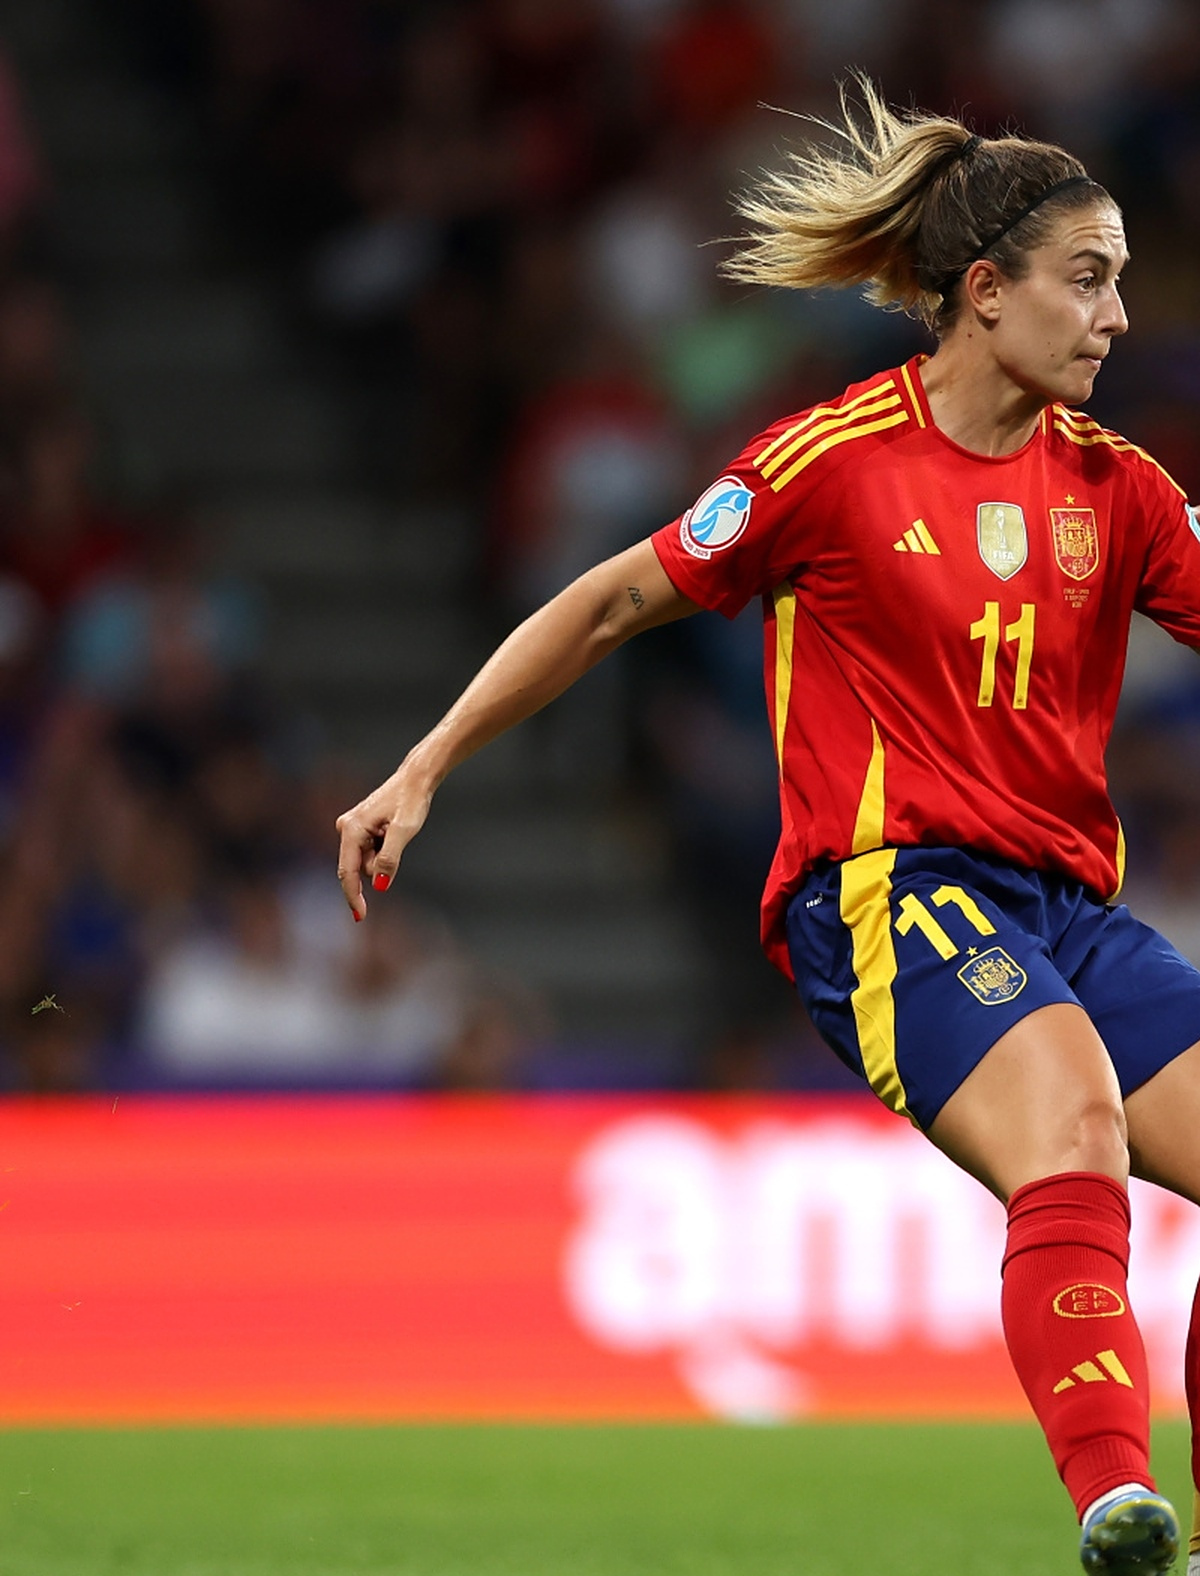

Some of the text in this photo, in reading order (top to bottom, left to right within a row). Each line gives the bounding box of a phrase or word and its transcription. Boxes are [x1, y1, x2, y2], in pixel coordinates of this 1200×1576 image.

[993, 550, 1015, 561] FIFA
[970, 601, 1036, 709] 11
[894, 884, 997, 961] 11
